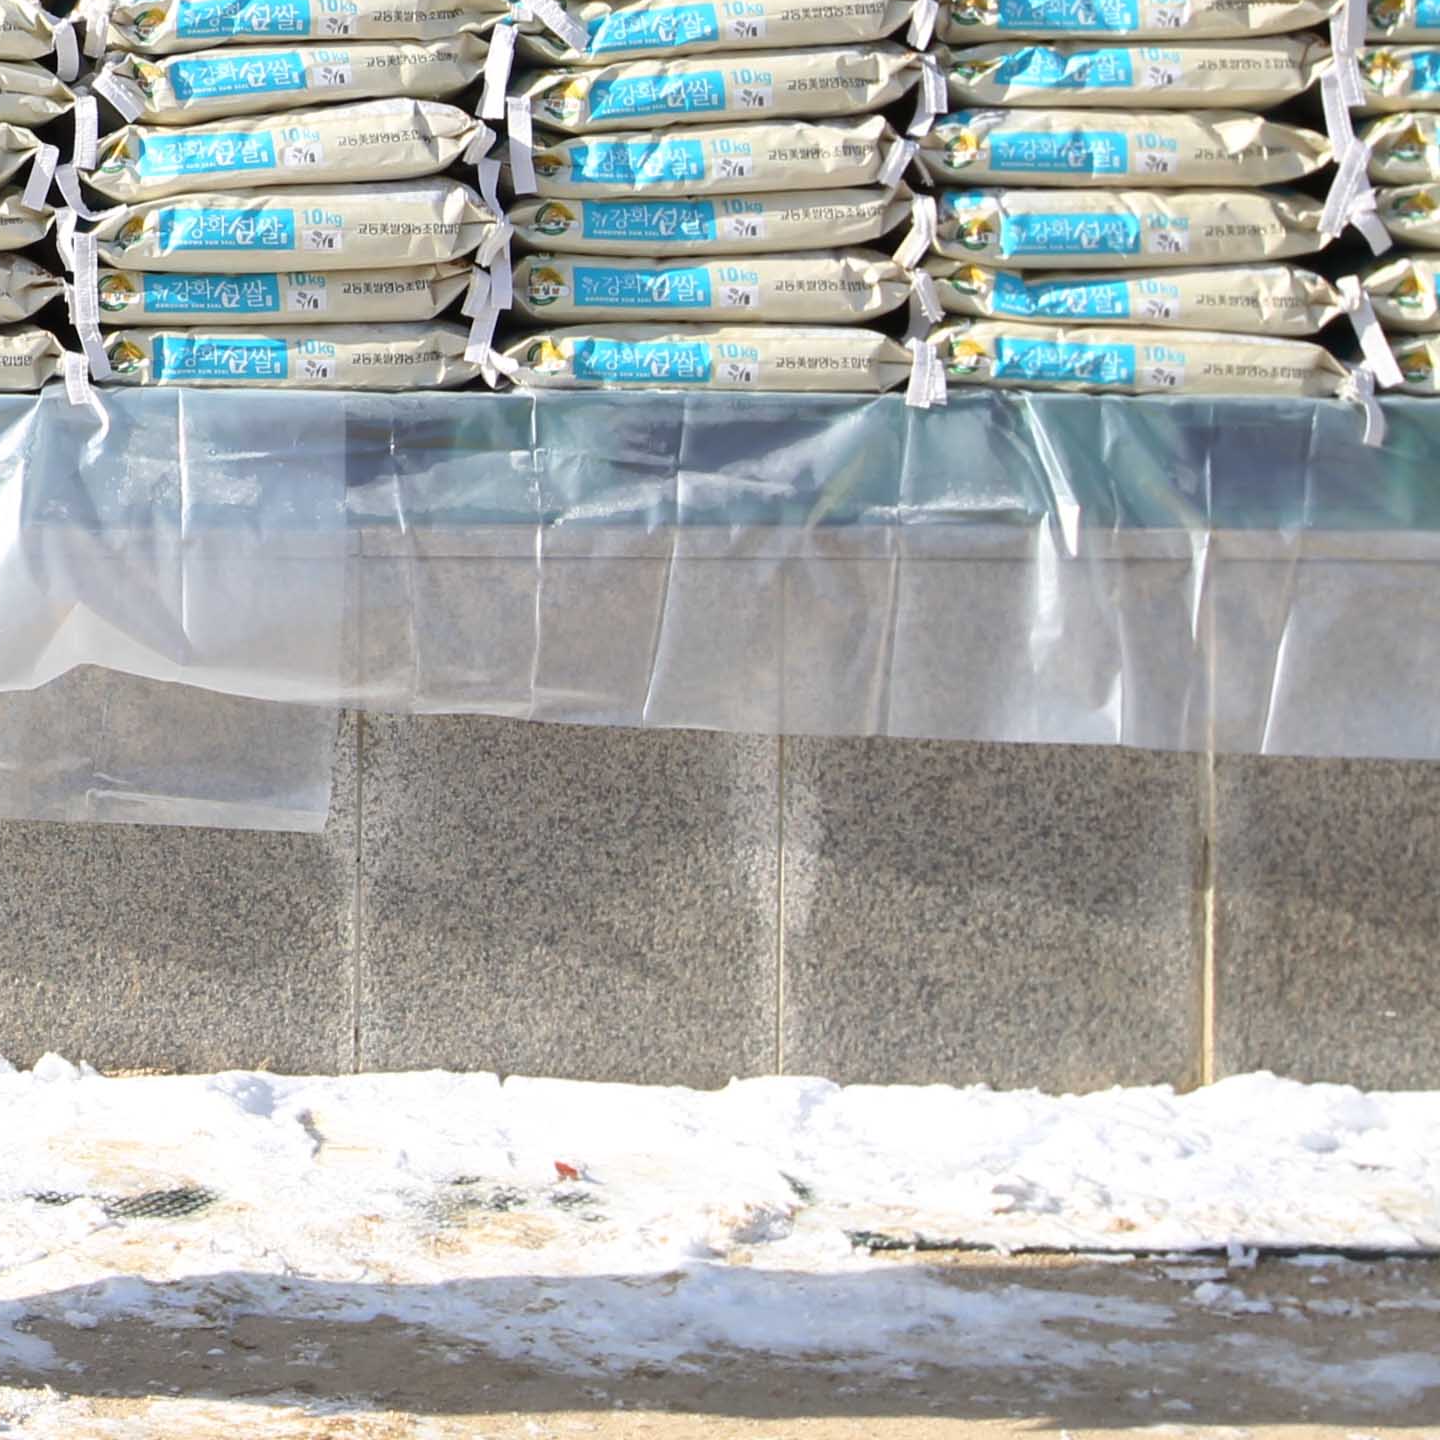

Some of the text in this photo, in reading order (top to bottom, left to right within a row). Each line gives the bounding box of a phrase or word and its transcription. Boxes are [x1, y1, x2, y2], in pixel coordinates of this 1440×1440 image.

[723, 0, 764, 17] 10kg
[310, 50, 350, 66] 10kg
[1140, 47, 1180, 64] 10kg
[732, 68, 773, 86] 10kg
[280, 128, 320, 143] 10kg
[1137, 134, 1178, 151] 10kg
[711, 138, 752, 155] 10kg
[723, 199, 763, 216] 10kg
[303, 209, 344, 227] 10kg
[287, 272, 326, 288] 10kg
[718, 267, 758, 284] 10kg
[1139, 281, 1179, 298] 10kg
[296, 339, 335, 357] 10kg
[718, 343, 758, 361] 10kg
[1143, 346, 1186, 364] 10kg
